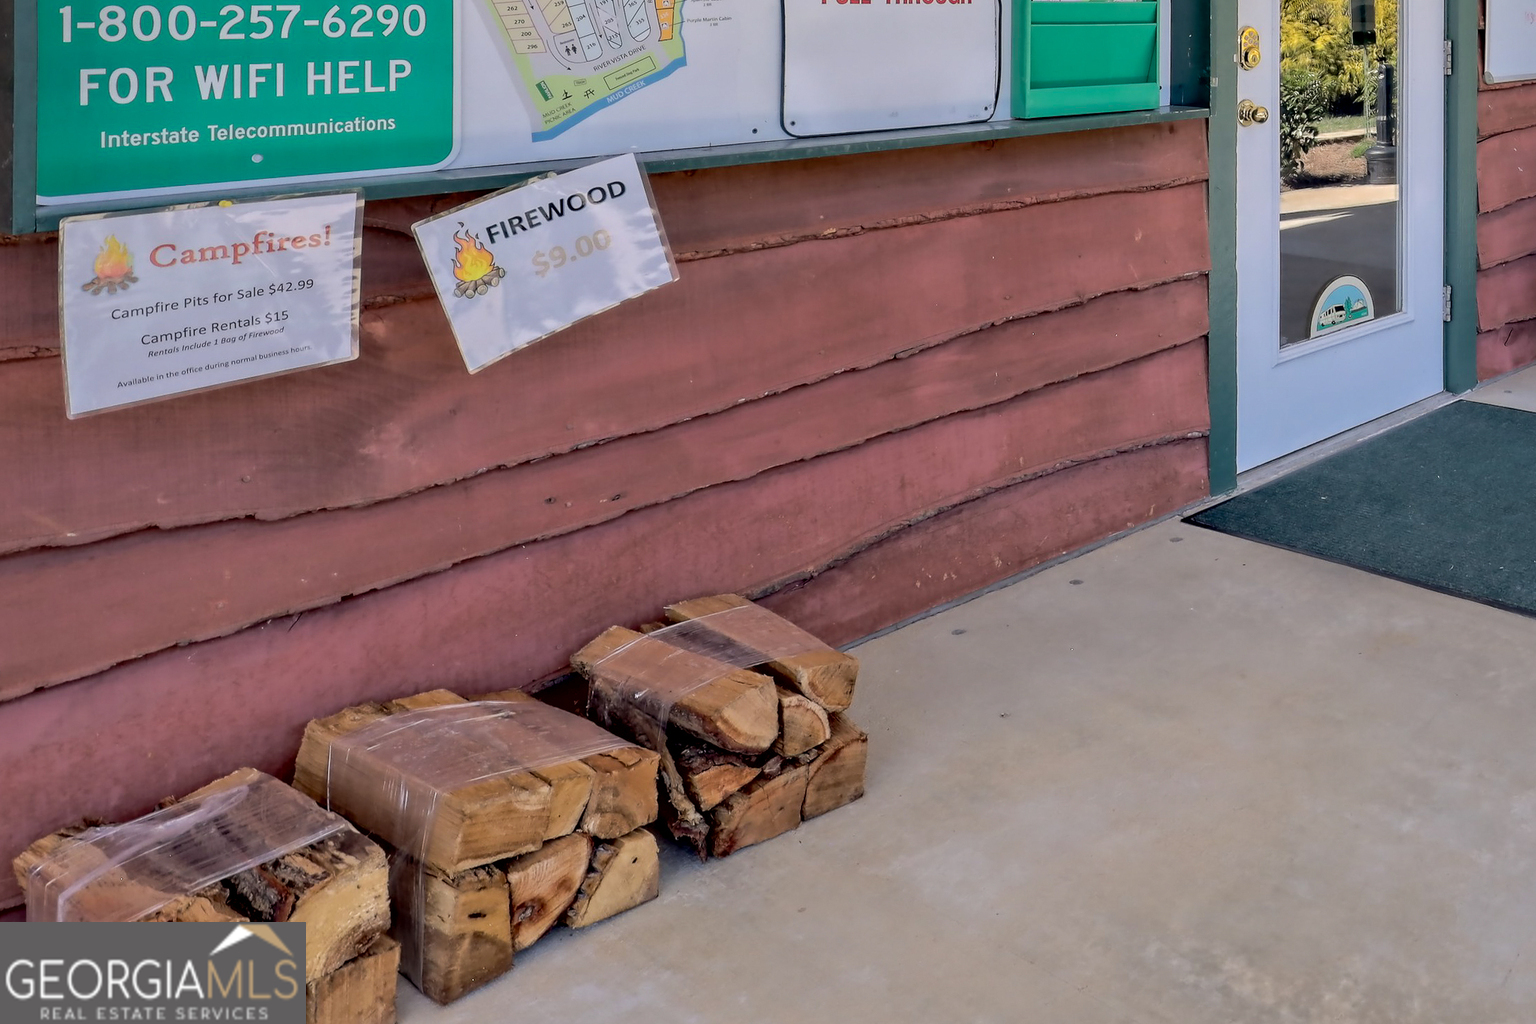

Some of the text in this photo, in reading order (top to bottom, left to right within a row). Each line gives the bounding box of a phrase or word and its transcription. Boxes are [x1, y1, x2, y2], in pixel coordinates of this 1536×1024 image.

[59, 3, 427, 43] 1-800-257-6290
[79, 59, 412, 106] FOR WIFI HELP
[606, 81, 646, 104] MUD CREEK
[100, 116, 396, 149] Interstate Telecommunications
[485, 180, 627, 244] FIREWOOD
[149, 225, 331, 268] Campfires!
[531, 228, 612, 277] $9.00
[111, 278, 314, 320] Campfire Pits for Sale $42.99
[141, 309, 289, 345] Campfire Rentals $15
[148, 346, 179, 358] Rentals
[181, 340, 211, 354] Include
[221, 336, 236, 345] Bag
[238, 333, 247, 341] of
[248, 326, 285, 339] Firewood
[117, 375, 155, 388] Available
[166, 370, 179, 378] the
[181, 365, 203, 375] office
[205, 361, 229, 370] during
[231, 354, 257, 365] normal
[258, 348, 289, 360] business
